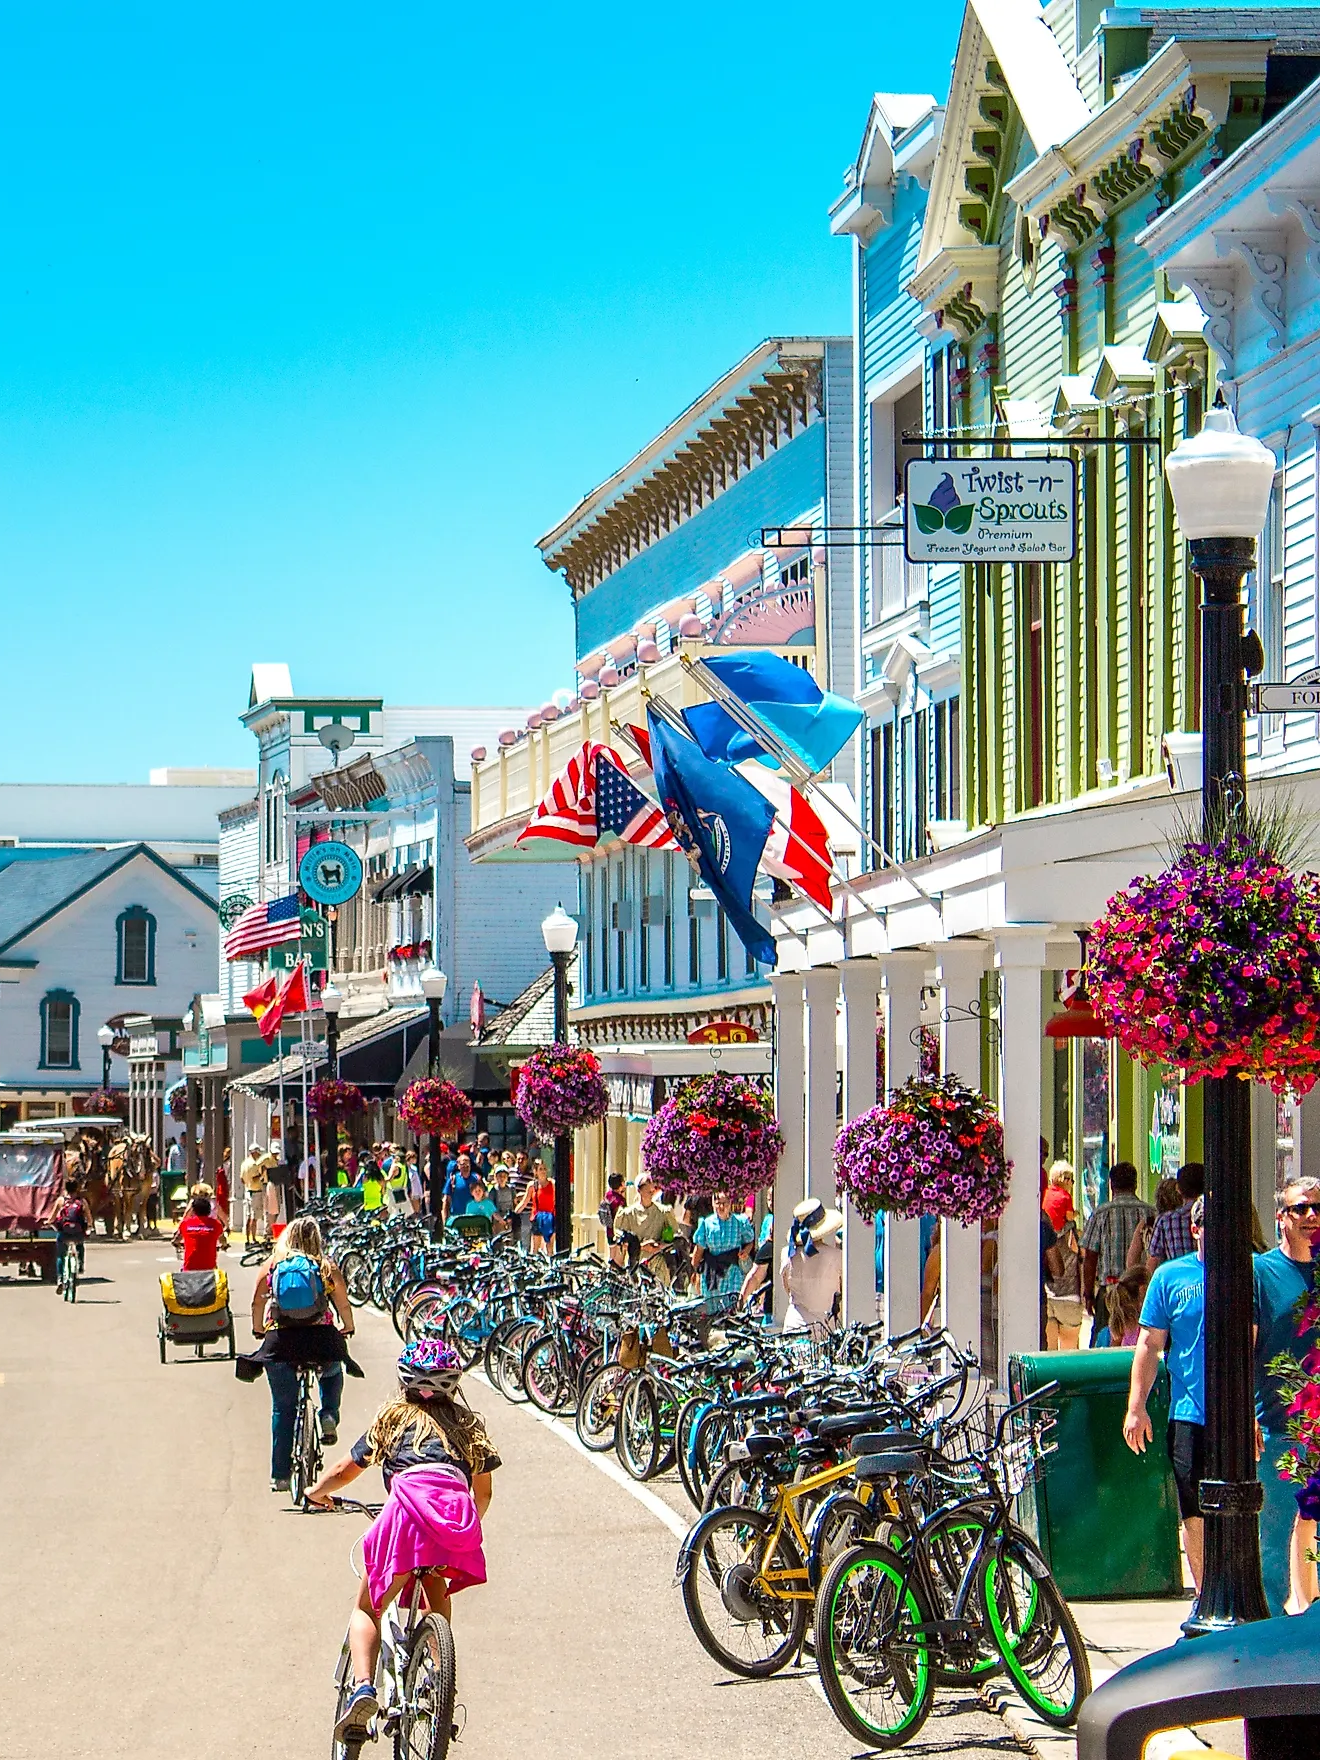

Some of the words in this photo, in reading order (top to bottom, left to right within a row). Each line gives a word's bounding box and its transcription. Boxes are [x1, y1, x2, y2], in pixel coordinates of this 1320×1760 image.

[961, 466, 1024, 494] Twist
[976, 496, 1069, 526] Sprouts
[977, 527, 1033, 541] Premium
[926, 543, 961, 554] Frozen
[998, 543, 1016, 553] and
[1017, 542, 1046, 554] Salad
[1048, 541, 1067, 553] Bar
[284, 952, 314, 968] BAR
